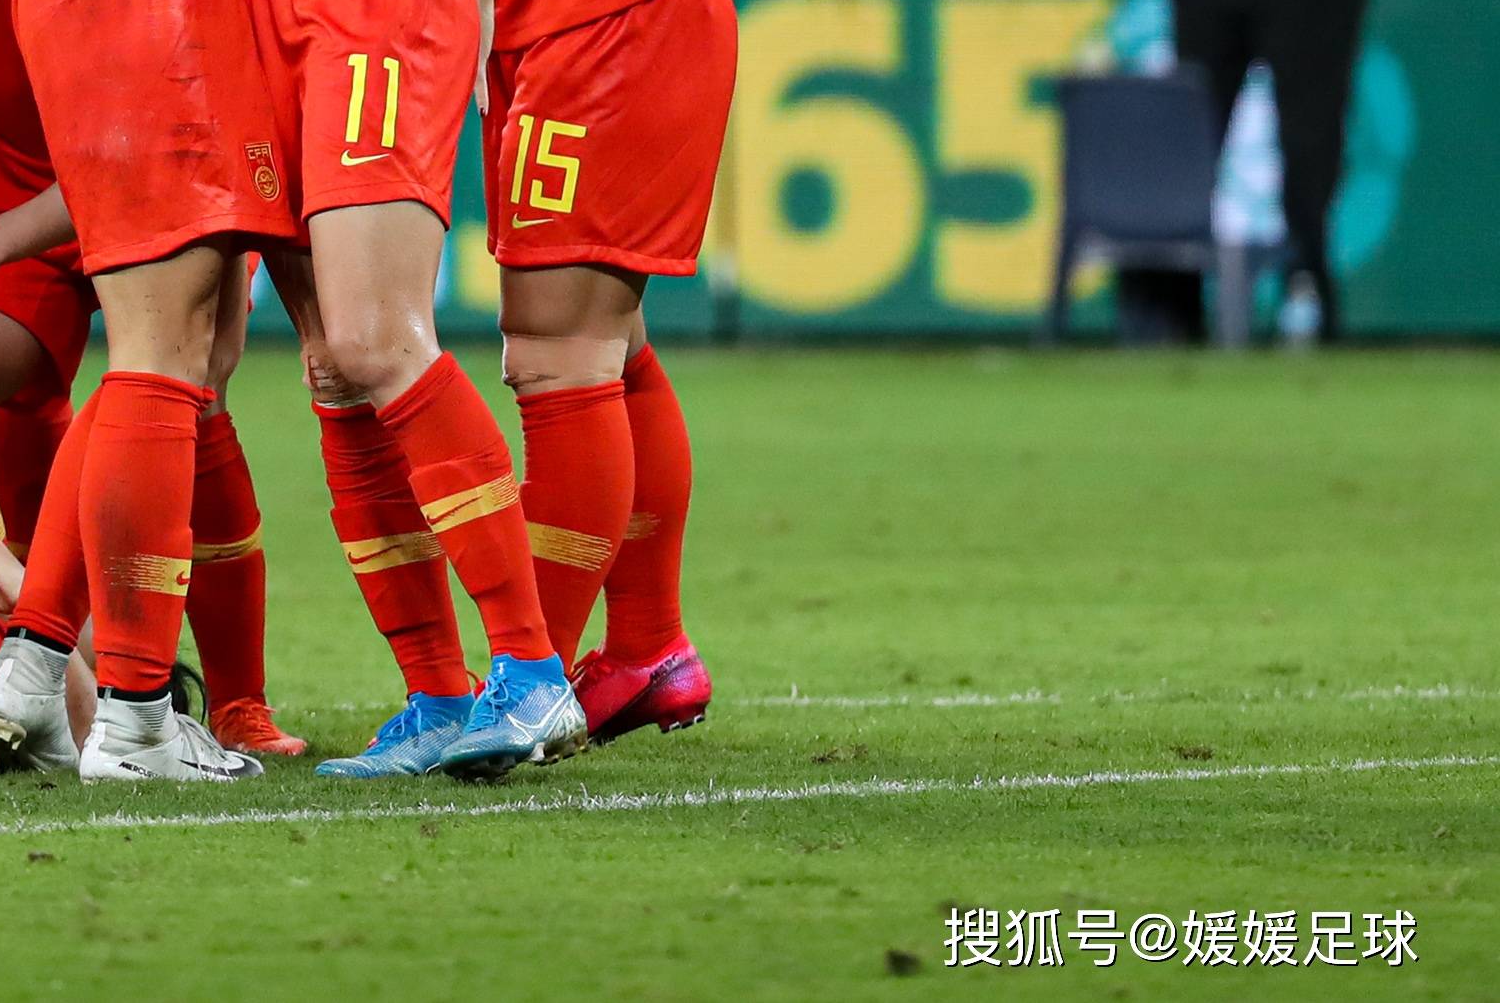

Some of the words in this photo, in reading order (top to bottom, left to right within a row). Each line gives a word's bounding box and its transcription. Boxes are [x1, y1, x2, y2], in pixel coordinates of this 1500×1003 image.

[346, 53, 400, 148] 11
[247, 147, 269, 160] CFA
[510, 114, 588, 214] 15
